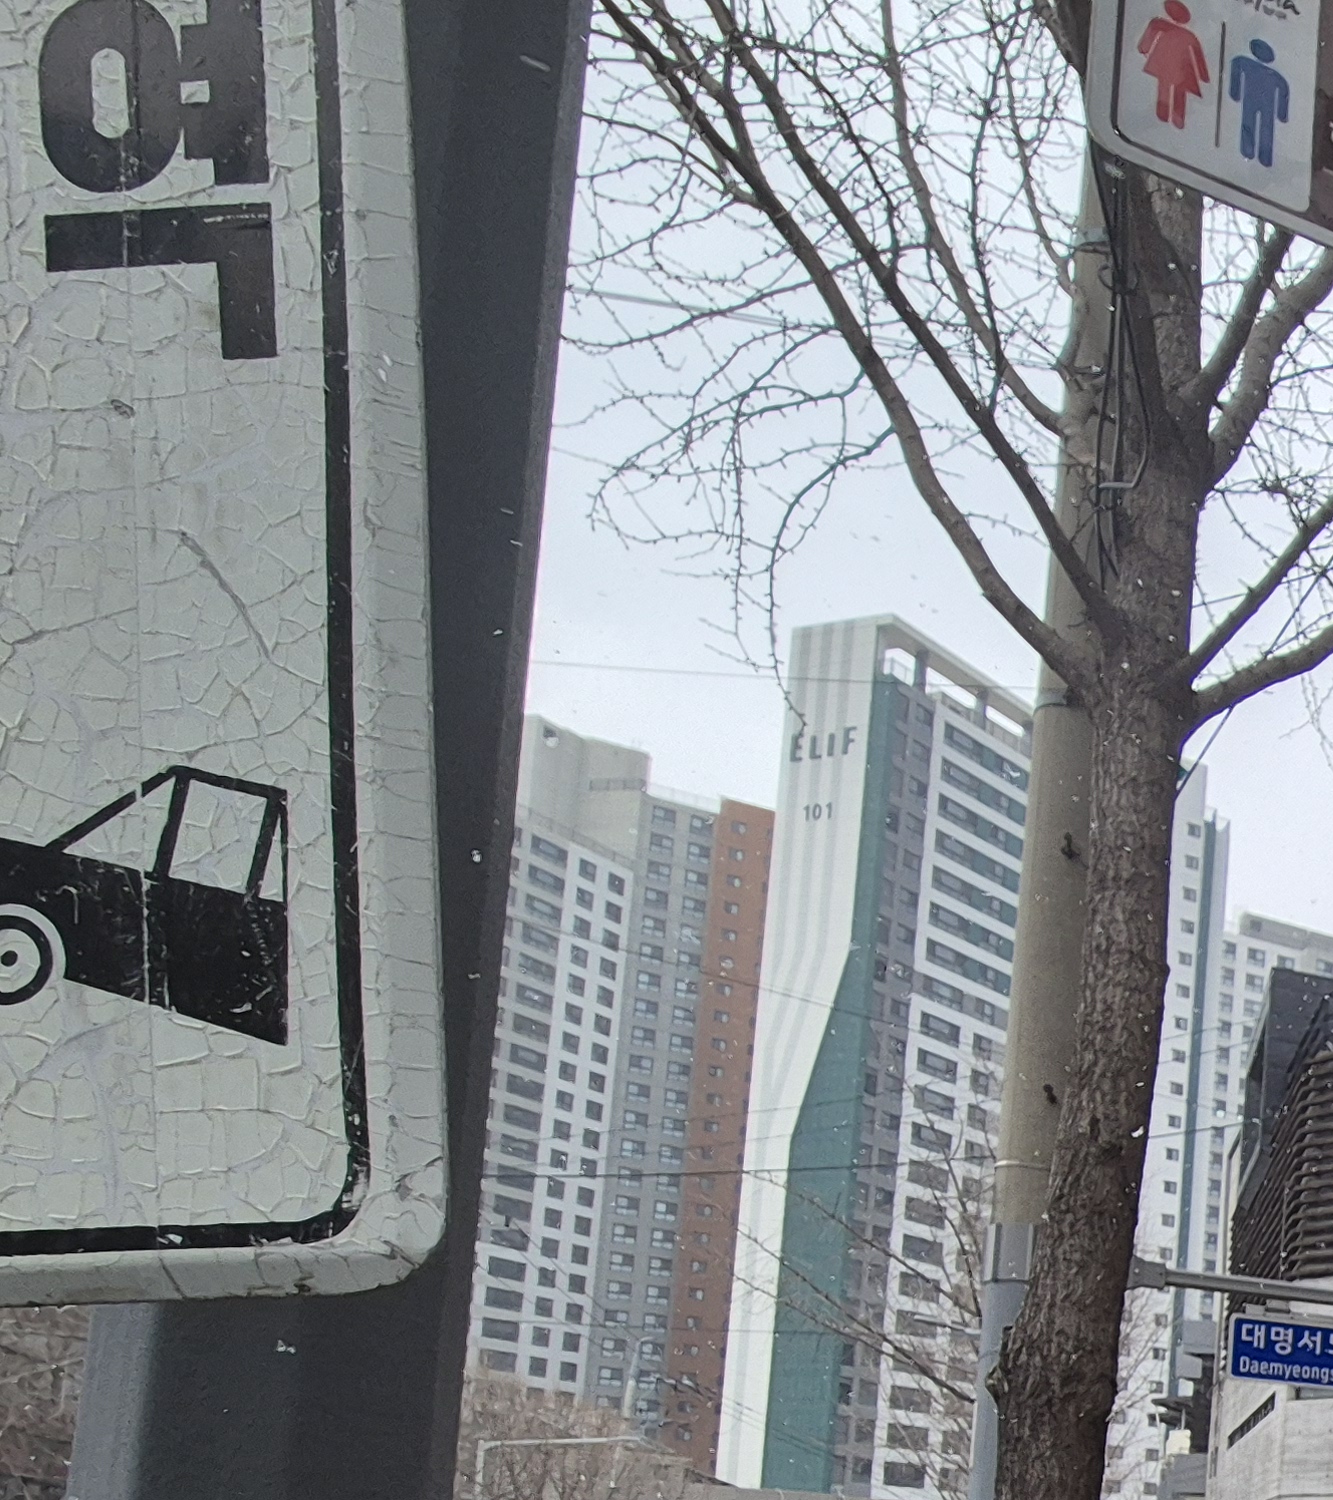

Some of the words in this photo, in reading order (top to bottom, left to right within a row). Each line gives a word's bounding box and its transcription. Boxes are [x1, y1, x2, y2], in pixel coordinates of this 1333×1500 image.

[38, 0, 278, 361] 역
[789, 726, 857, 763] ELIF
[802, 802, 833, 822] 101
